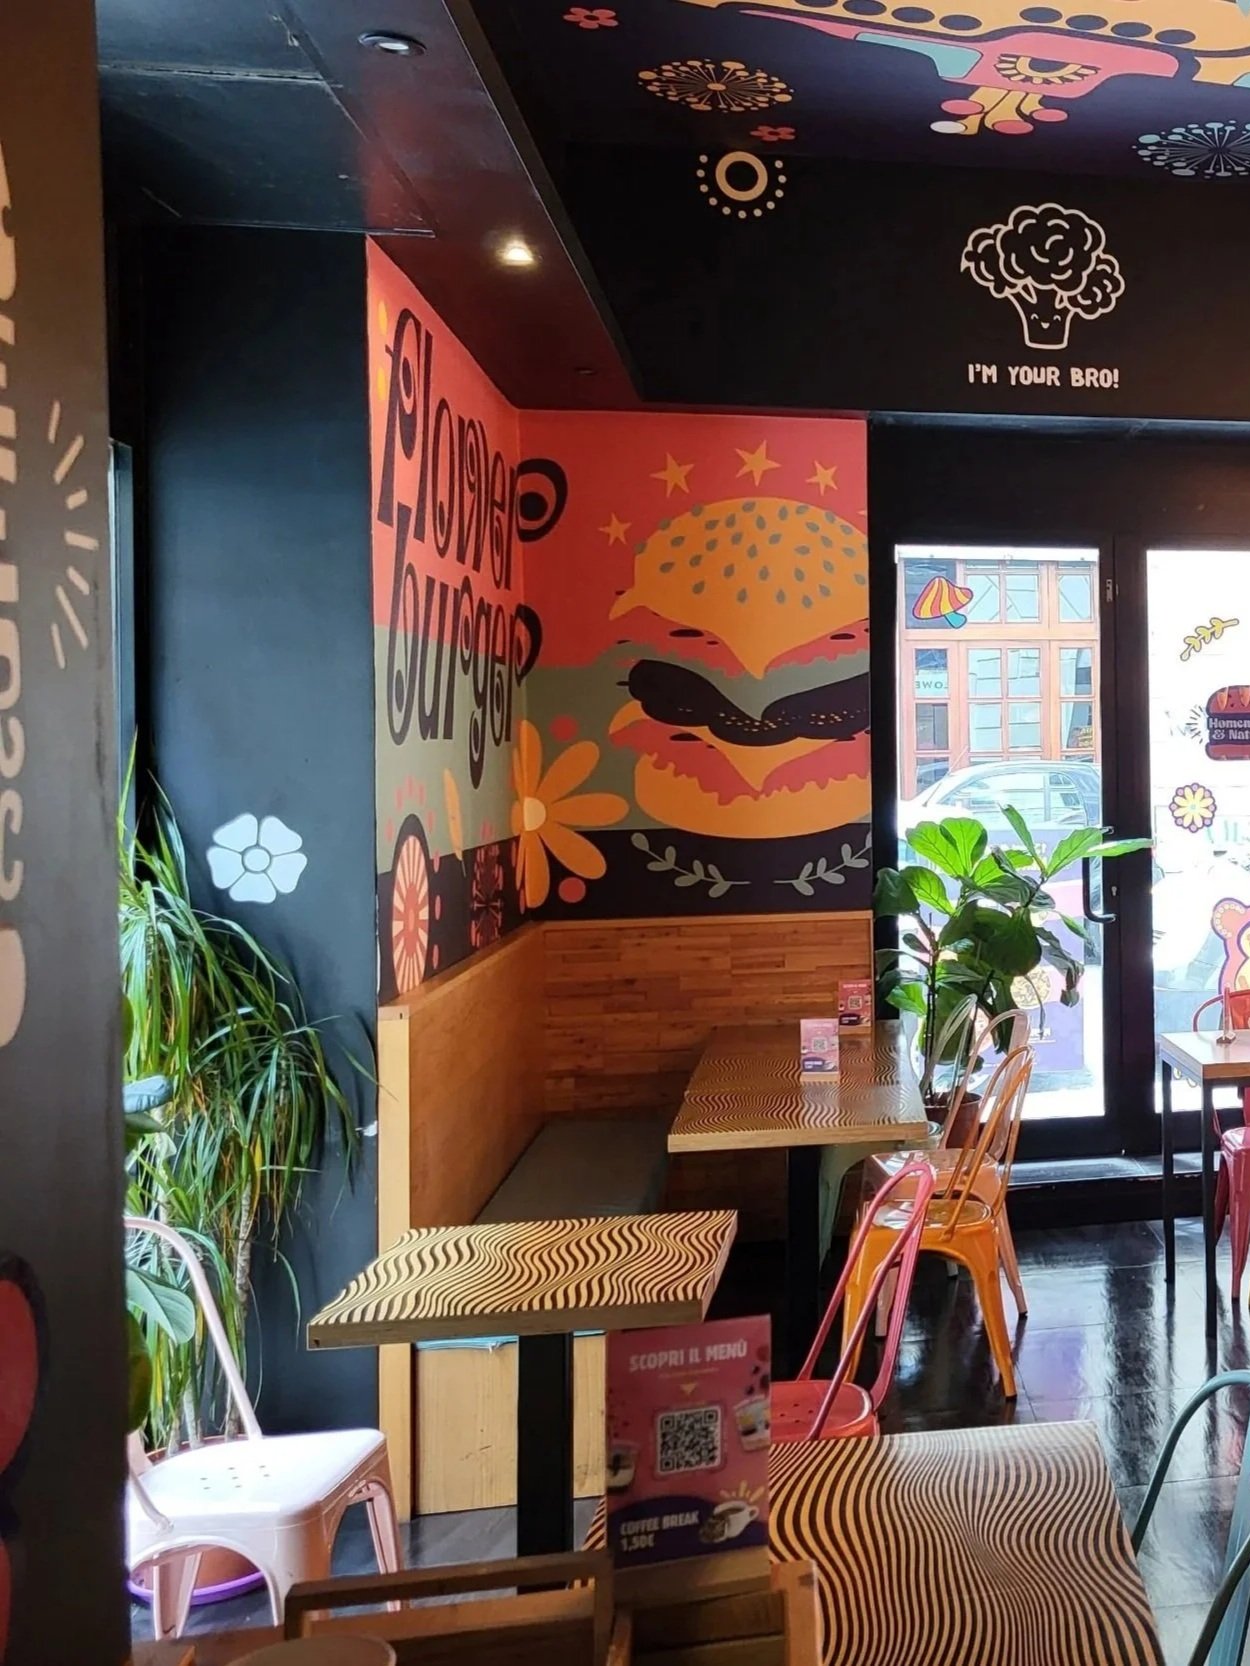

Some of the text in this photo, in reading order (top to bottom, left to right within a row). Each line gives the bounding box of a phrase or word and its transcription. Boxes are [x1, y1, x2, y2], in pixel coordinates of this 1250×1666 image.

[968, 364, 1119, 389] I'M YOUR BRO!
[1212, 729, 1225, 740] &
[629, 1349, 684, 1373] SCOPRI
[689, 1347, 701, 1364] IL
[705, 1339, 747, 1362] MENÙ
[620, 1510, 699, 1535] COFFEE BREAK
